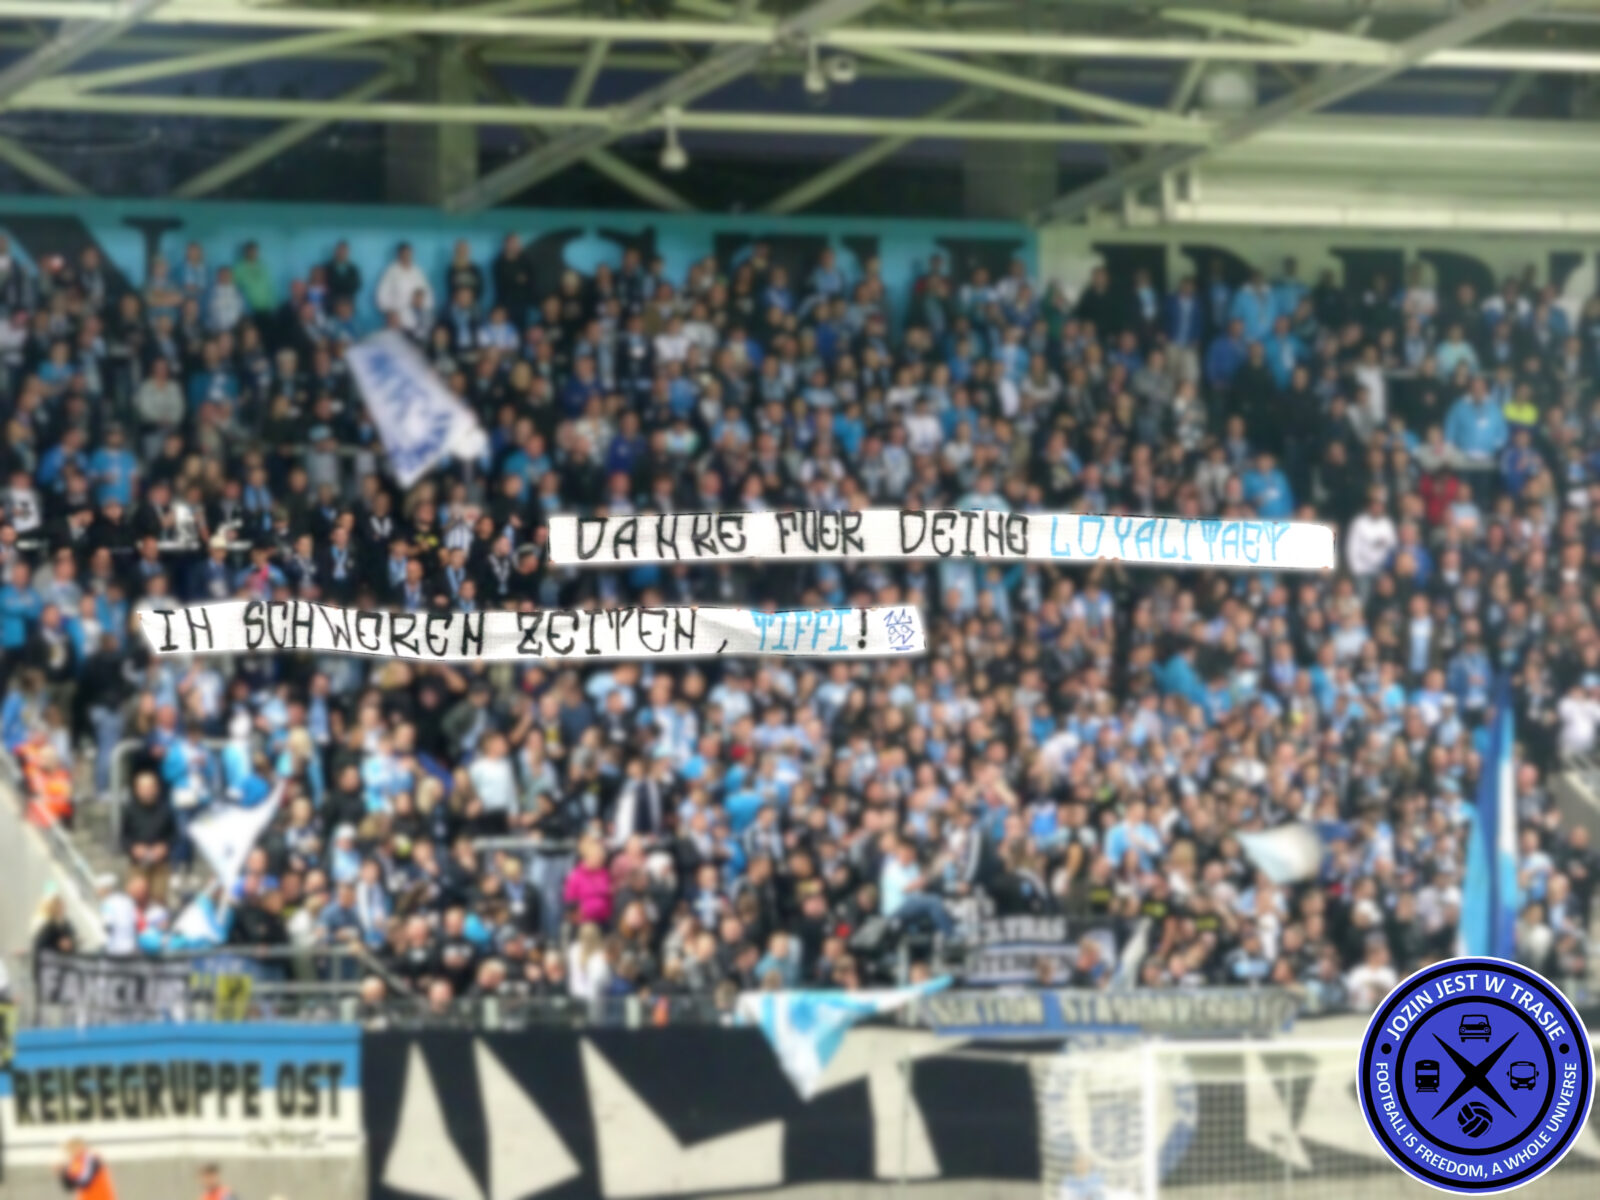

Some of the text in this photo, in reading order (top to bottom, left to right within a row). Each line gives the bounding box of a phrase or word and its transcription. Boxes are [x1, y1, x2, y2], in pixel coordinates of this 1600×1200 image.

[775, 510, 864, 554] FUER
[901, 510, 1029, 557] DEINE
[243, 601, 485, 657] SCHWEREN
[12, 1061, 345, 1126] REISEGRUPPE OST
